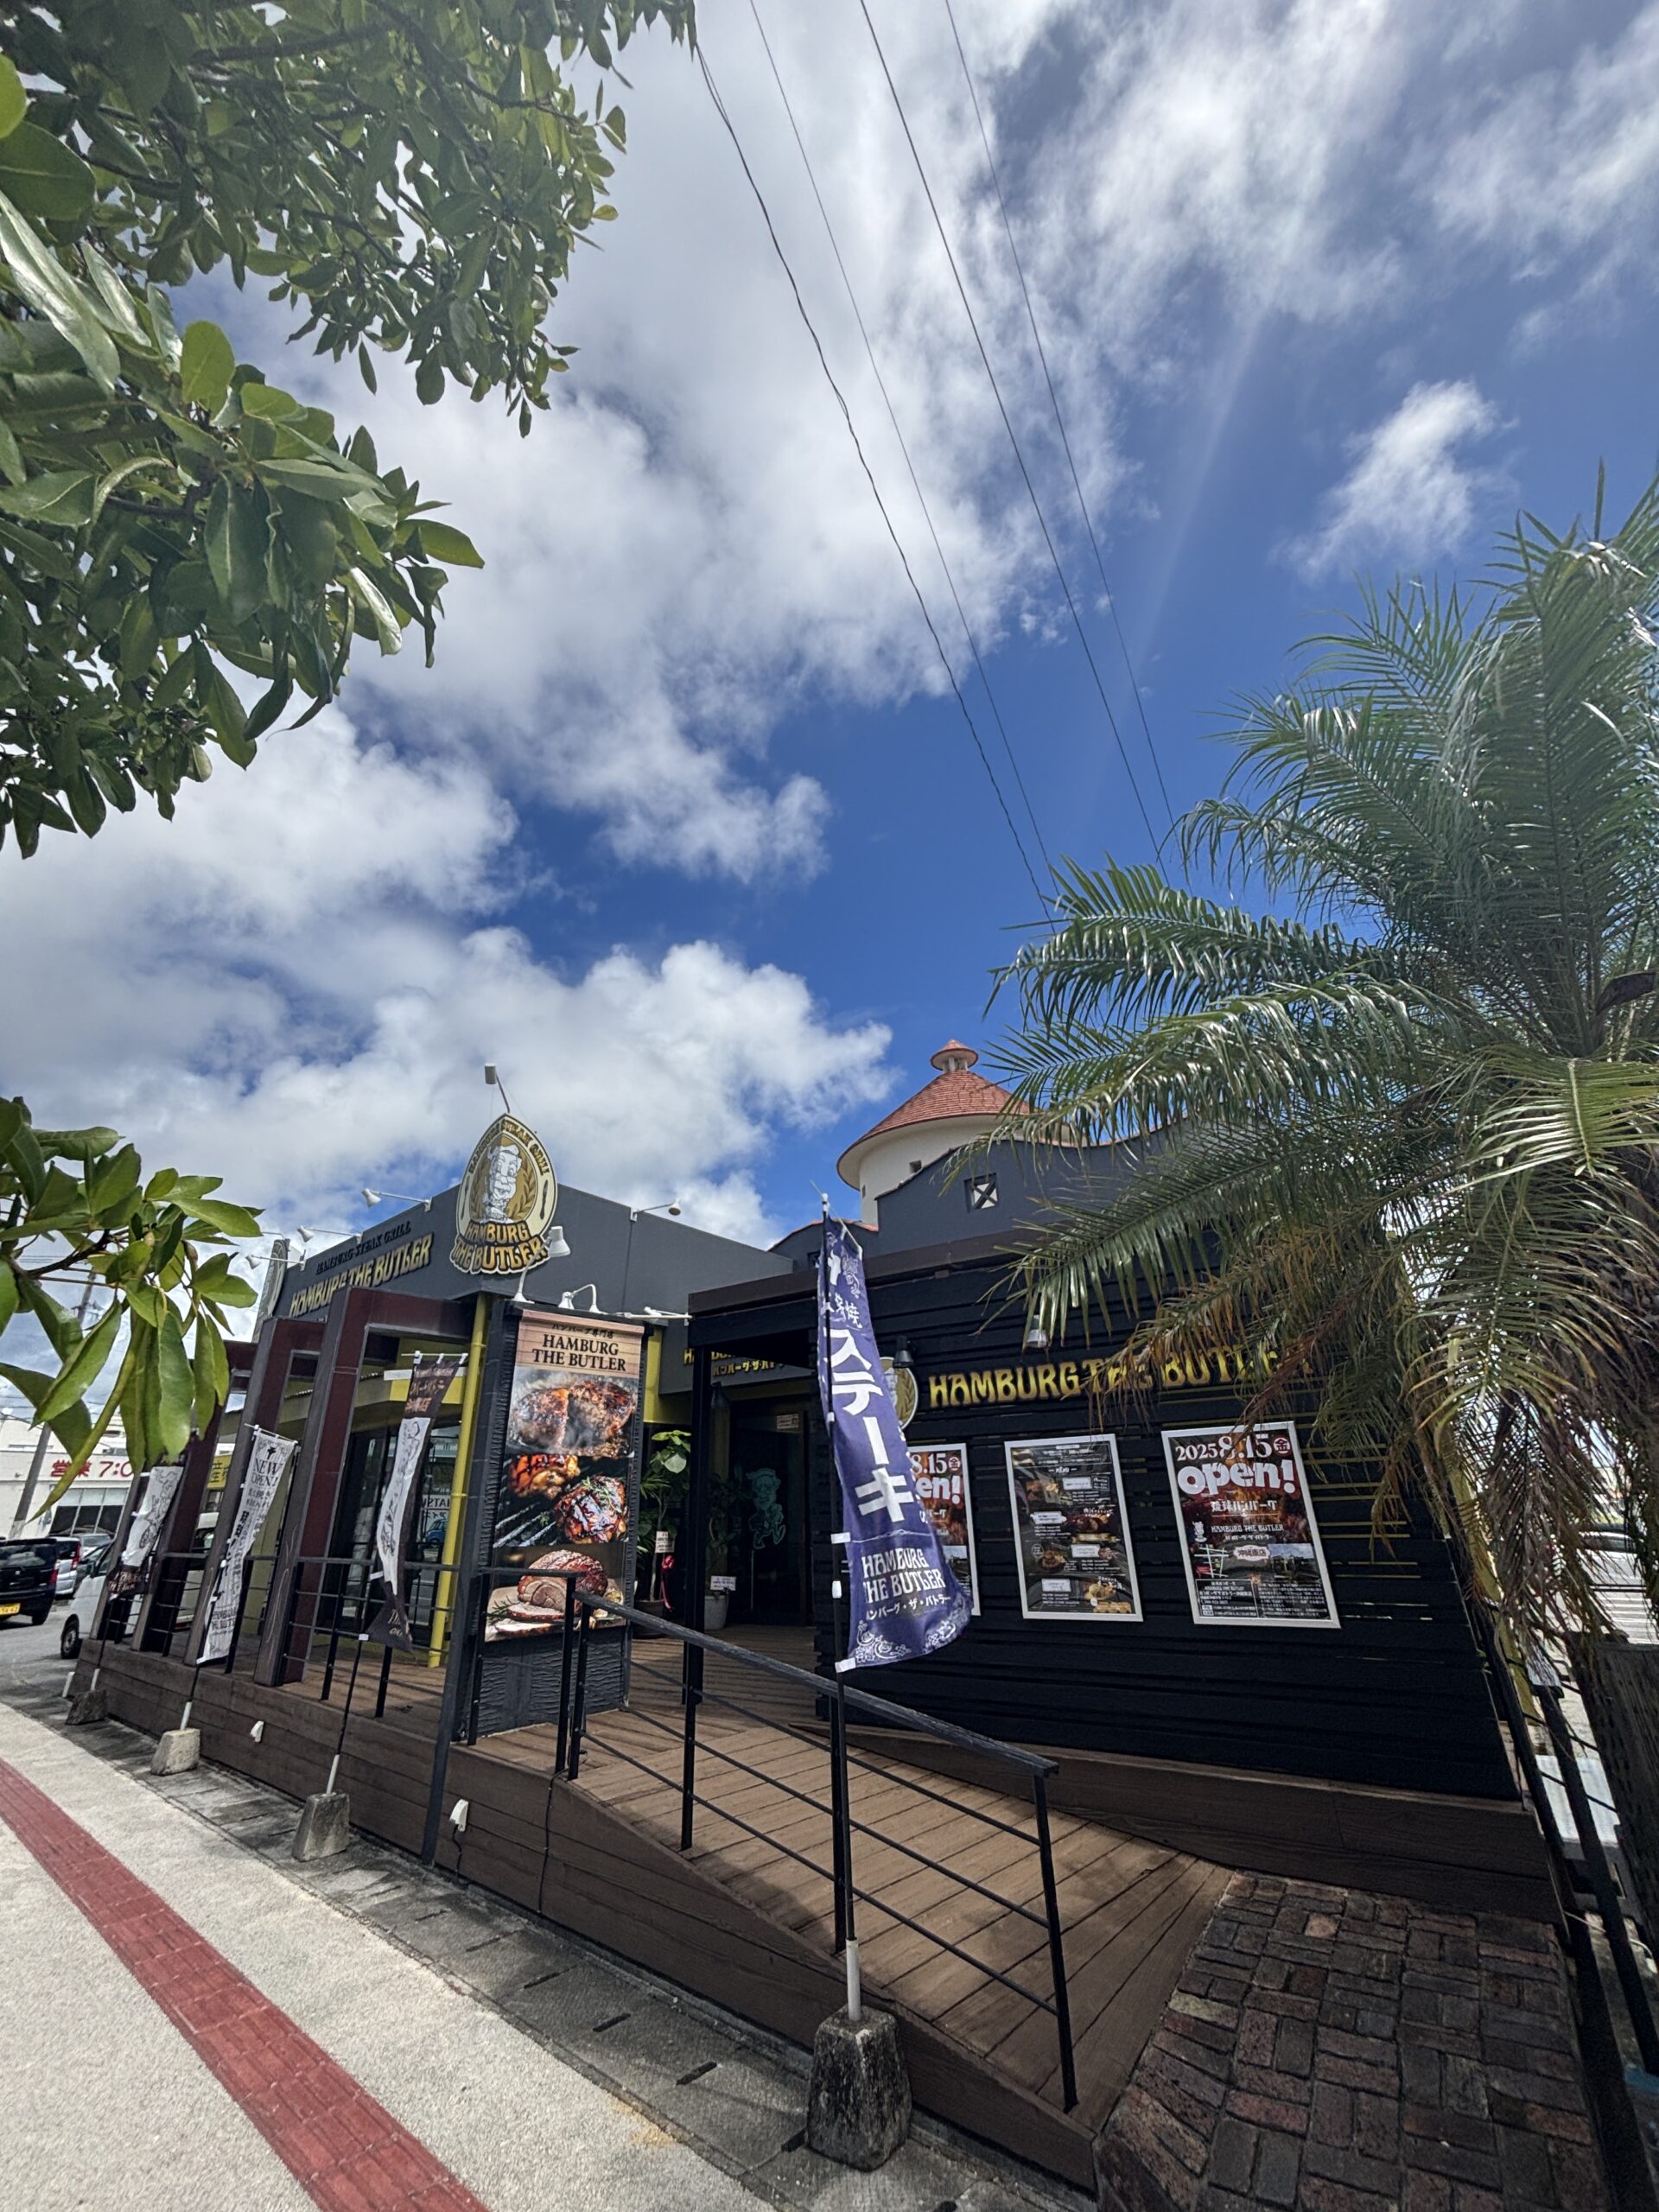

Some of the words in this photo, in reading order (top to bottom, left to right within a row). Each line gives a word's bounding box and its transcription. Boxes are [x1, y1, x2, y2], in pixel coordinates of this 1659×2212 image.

[501, 1119, 534, 1148] STEAK
[530, 1143, 550, 1176] GRILL
[355, 1234, 382, 1256] STEAK
[384, 1220, 412, 1244] GRILL
[465, 1222, 531, 1244] HAMBURG
[347, 1262, 373, 1288] THE
[372, 1232, 434, 1288] BUTLER
[451, 1237, 473, 1271] THE
[471, 1236, 550, 1271] BUTLER
[532, 1348, 565, 1365] THE
[569, 1352, 626, 1372] BUTLER
[543, 1333, 620, 1356] HAMBURG
[928, 1360, 1080, 1408] HAMBURG
[1161, 1341, 1314, 1388] BUTLE
[823, 1328, 914, 1523] ステーキ
[1175, 1442, 1219, 1462] 2025
[1217, 1433, 1273, 1460] 8.15
[1274, 1438, 1291, 1454] 金
[251, 1471, 278, 1487] OPEN!
[253, 1458, 283, 1475] NEW
[912, 1452, 947, 1475] 8.15
[1177, 1459, 1297, 1497] open!
[1258, 1523, 1284, 1532] BUTLER
[861, 1548, 929, 1579] HAMBURG
[863, 1578, 889, 1604] HE
[891, 1568, 946, 1597] BUTLER
